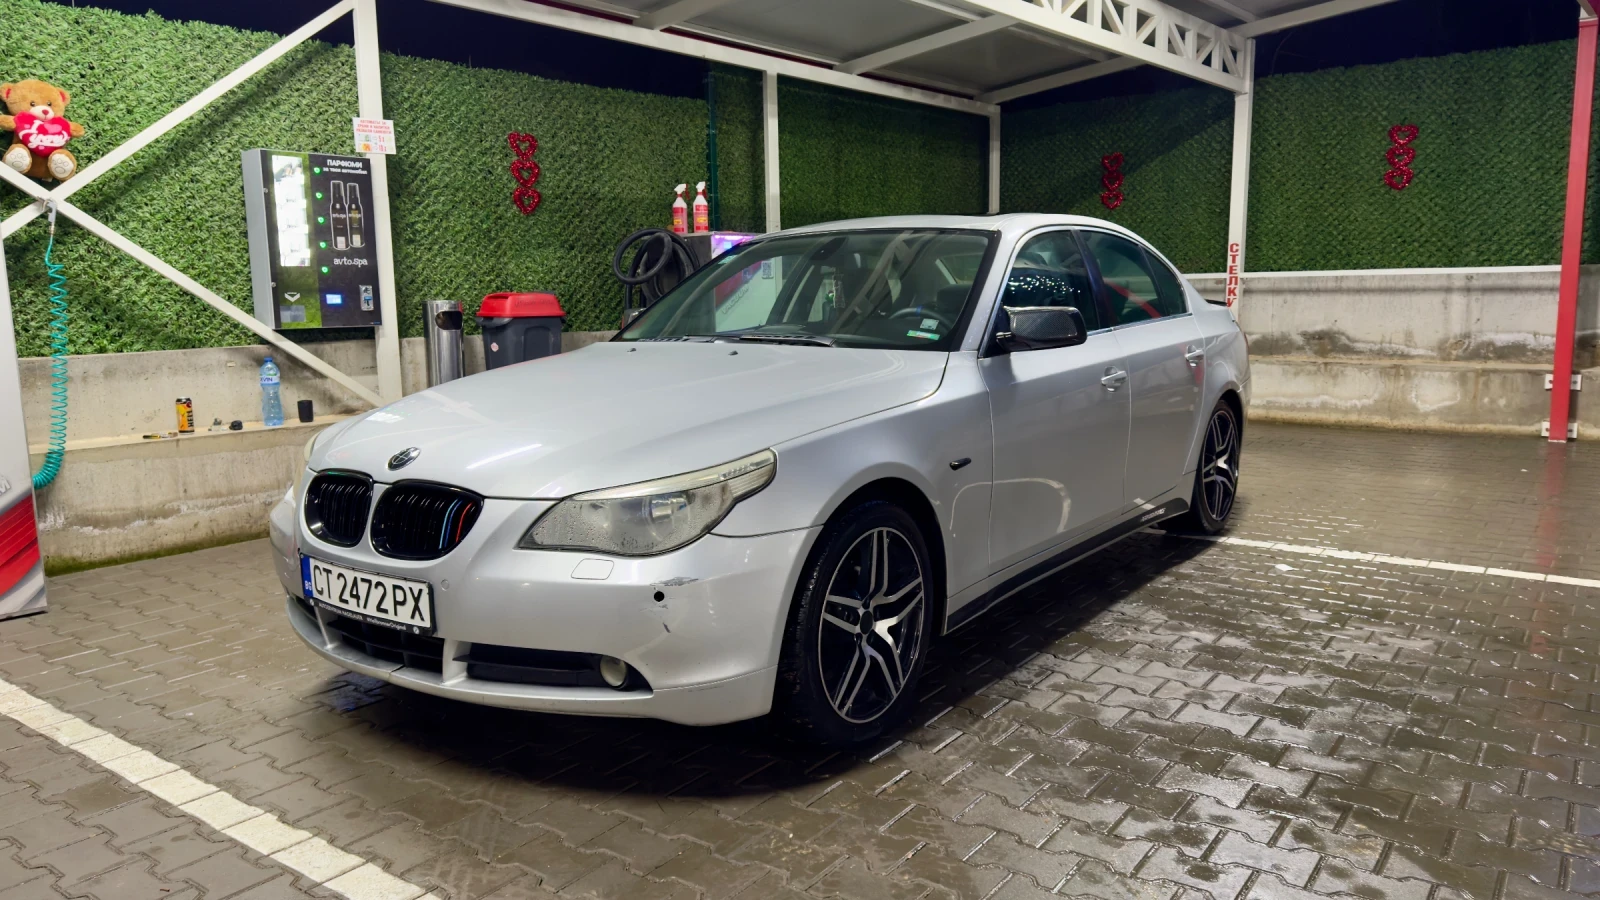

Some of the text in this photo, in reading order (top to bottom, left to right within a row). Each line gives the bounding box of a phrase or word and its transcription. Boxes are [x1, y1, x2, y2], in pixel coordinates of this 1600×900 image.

[327, 159, 363, 169] ПАРФЮМИ
[333, 256, 369, 268] avto.spa
[304, 580, 313, 591] BG
